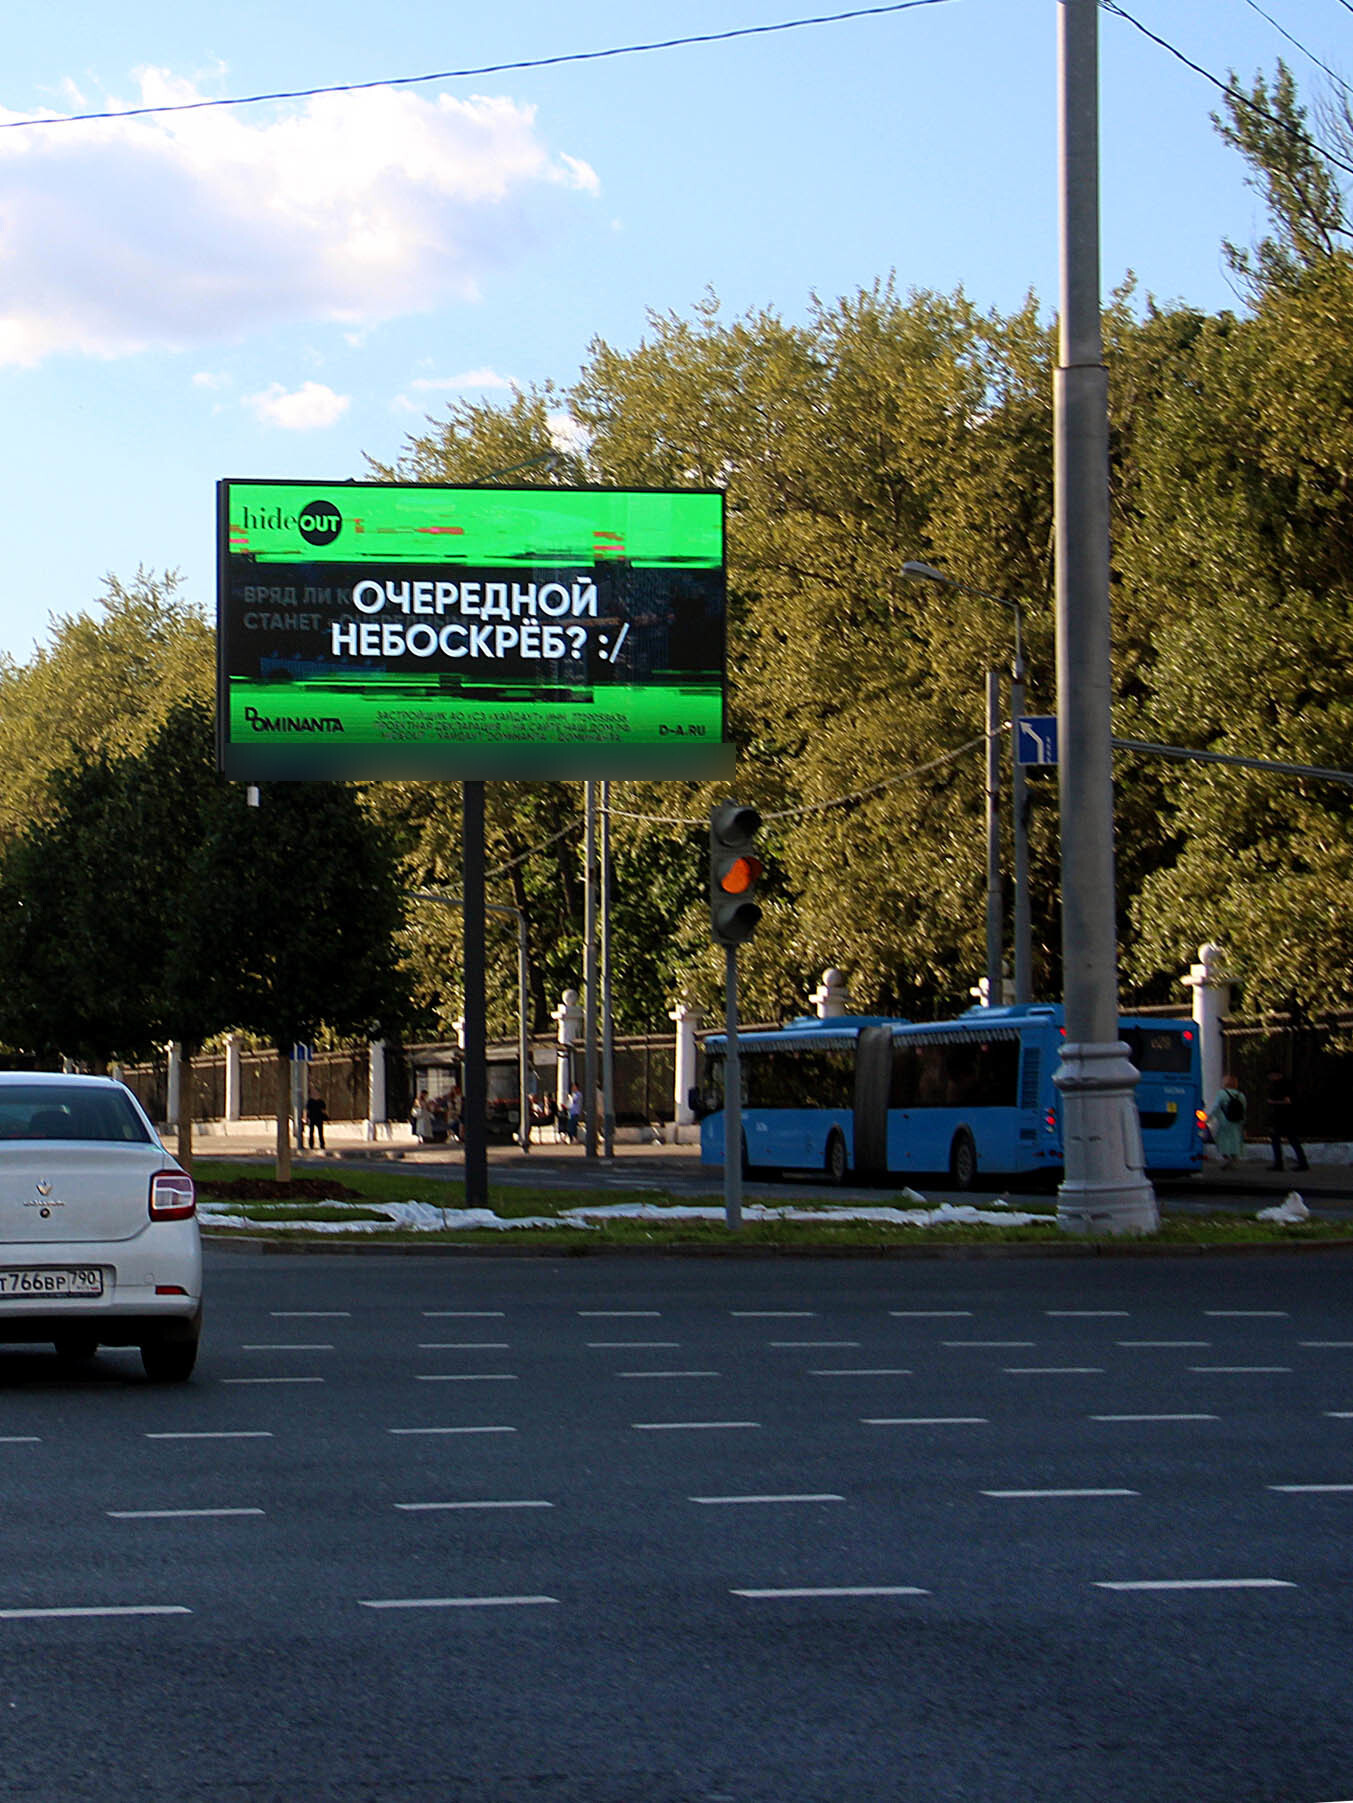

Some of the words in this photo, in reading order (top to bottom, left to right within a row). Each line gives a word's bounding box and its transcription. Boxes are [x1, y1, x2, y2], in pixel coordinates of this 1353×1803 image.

[243, 586, 297, 606] ВРЯД
[303, 587, 332, 605] ЛИ
[352, 577, 598, 621] ОЧЕРЕДНОЙ
[243, 612, 322, 630] СТАНЕТ
[331, 618, 588, 659] НЕБОСКРЁБ?
[244, 706, 344, 732] DOMINANTA
[658, 724, 706, 736] D-A.RU
[69, 1270, 96, 1285] 790
